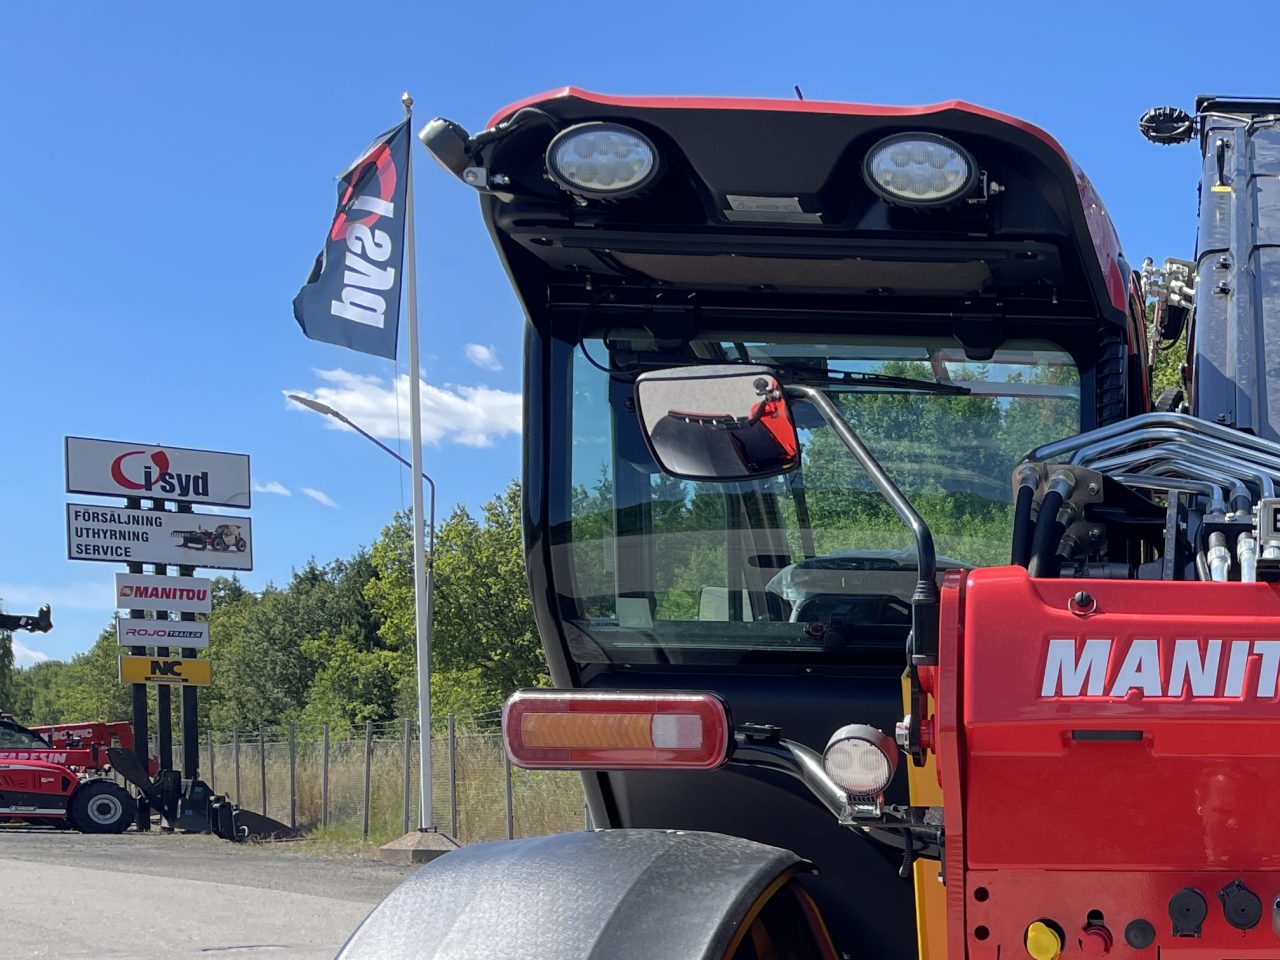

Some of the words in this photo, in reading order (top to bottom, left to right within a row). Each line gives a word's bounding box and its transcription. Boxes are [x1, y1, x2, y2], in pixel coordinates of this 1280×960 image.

[74, 508, 163, 528] FÖRSÄLJNING
[75, 526, 149, 543] UTHYRNING
[76, 543, 132, 558] SERVICE
[133, 585, 207, 601] MANITOU
[126, 628, 167, 638] ROJO
[150, 661, 183, 677] NC
